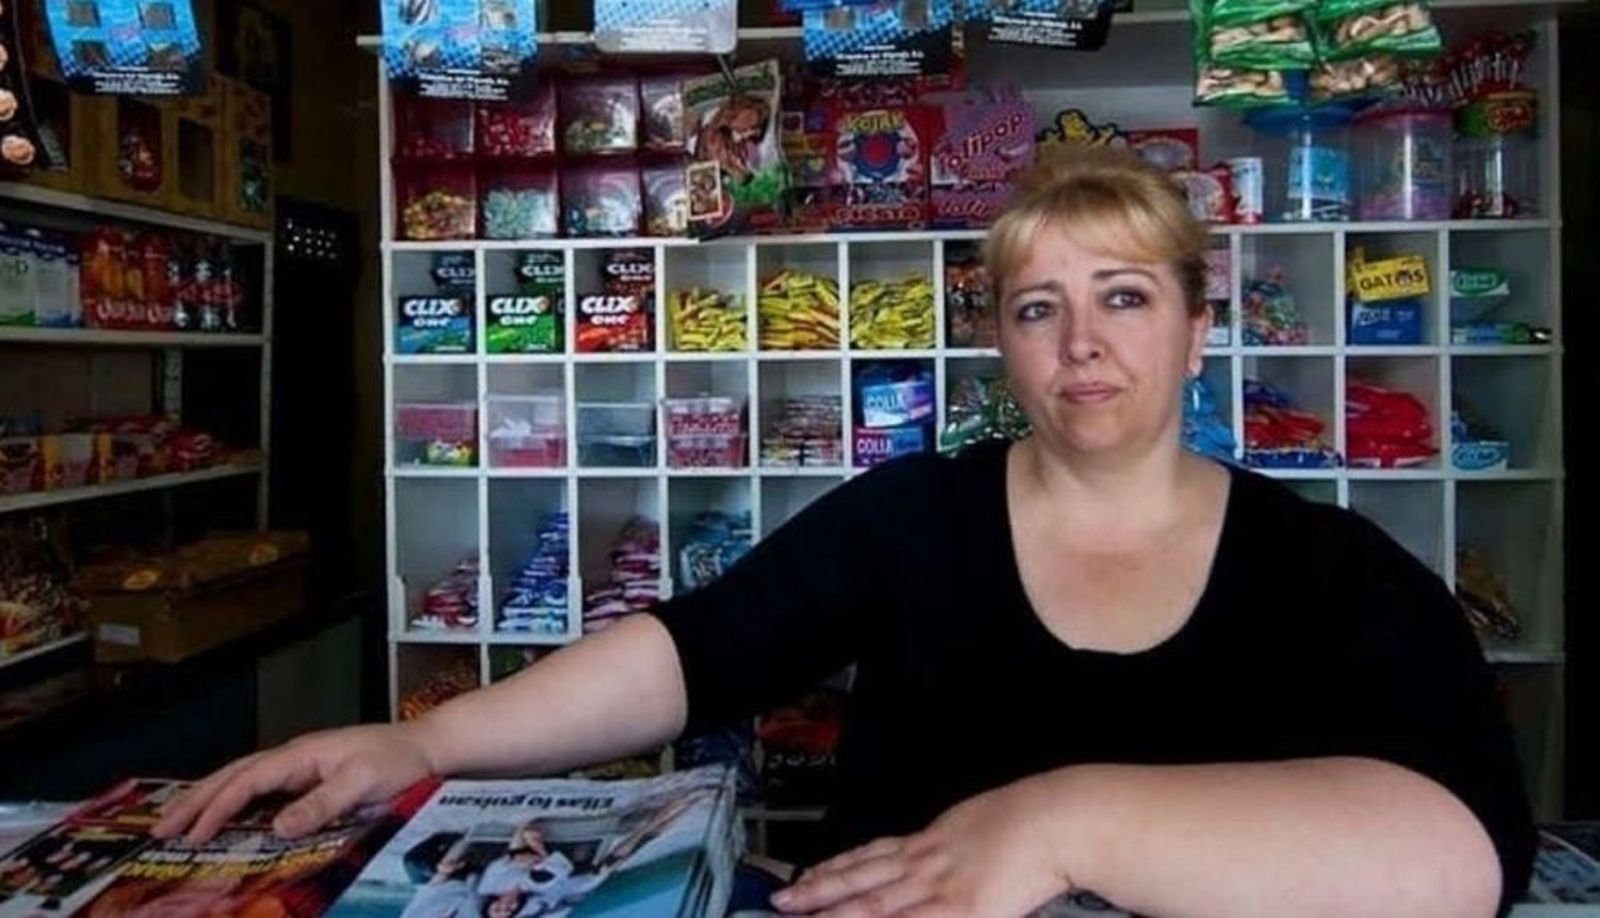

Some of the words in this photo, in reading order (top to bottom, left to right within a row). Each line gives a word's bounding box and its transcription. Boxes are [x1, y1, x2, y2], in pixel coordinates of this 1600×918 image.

[404, 298, 457, 316] CLIX
[491, 297, 543, 314] CLIX
[581, 296, 635, 313] CLIX
